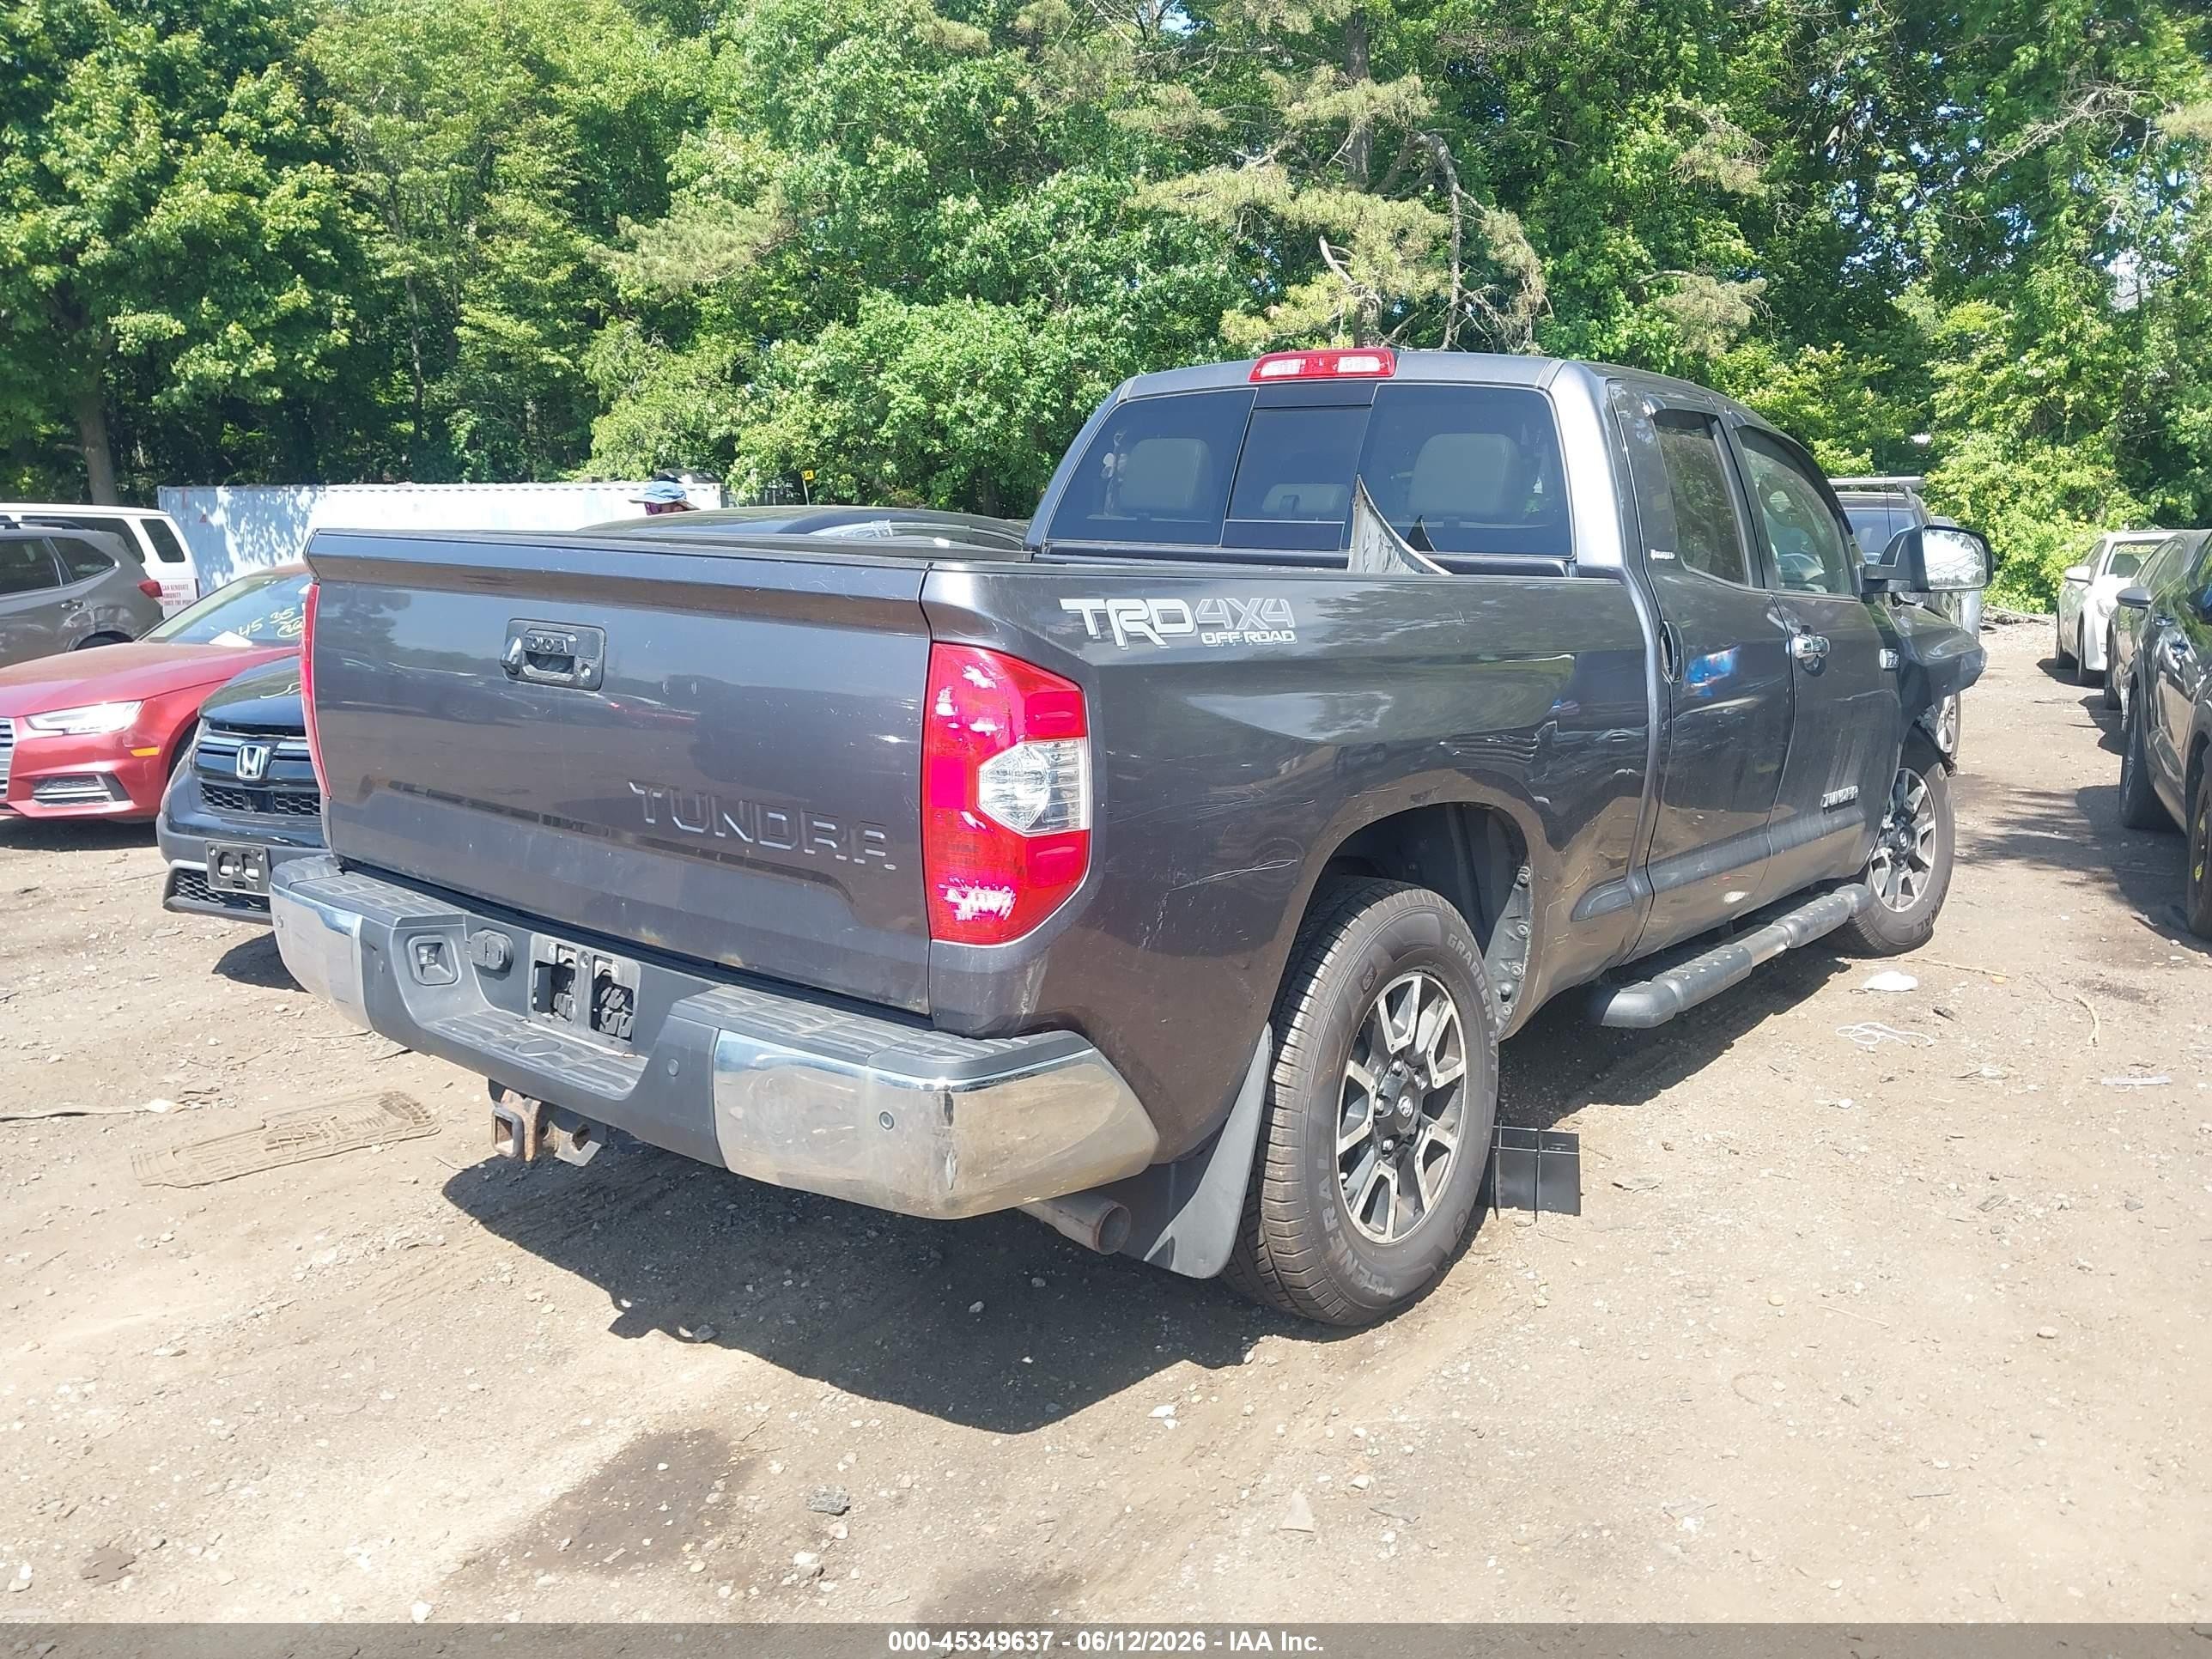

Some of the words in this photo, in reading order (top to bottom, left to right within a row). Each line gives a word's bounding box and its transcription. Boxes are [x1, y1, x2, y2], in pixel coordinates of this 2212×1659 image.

[1059, 599, 1199, 650] TRD
[1194, 598, 1296, 631] 4X4
[1201, 630, 1243, 646] OFF
[1243, 629, 1297, 646] ROAD
[628, 779, 896, 871] TUNDRA
[1446, 933, 1494, 1021] GRABBER
